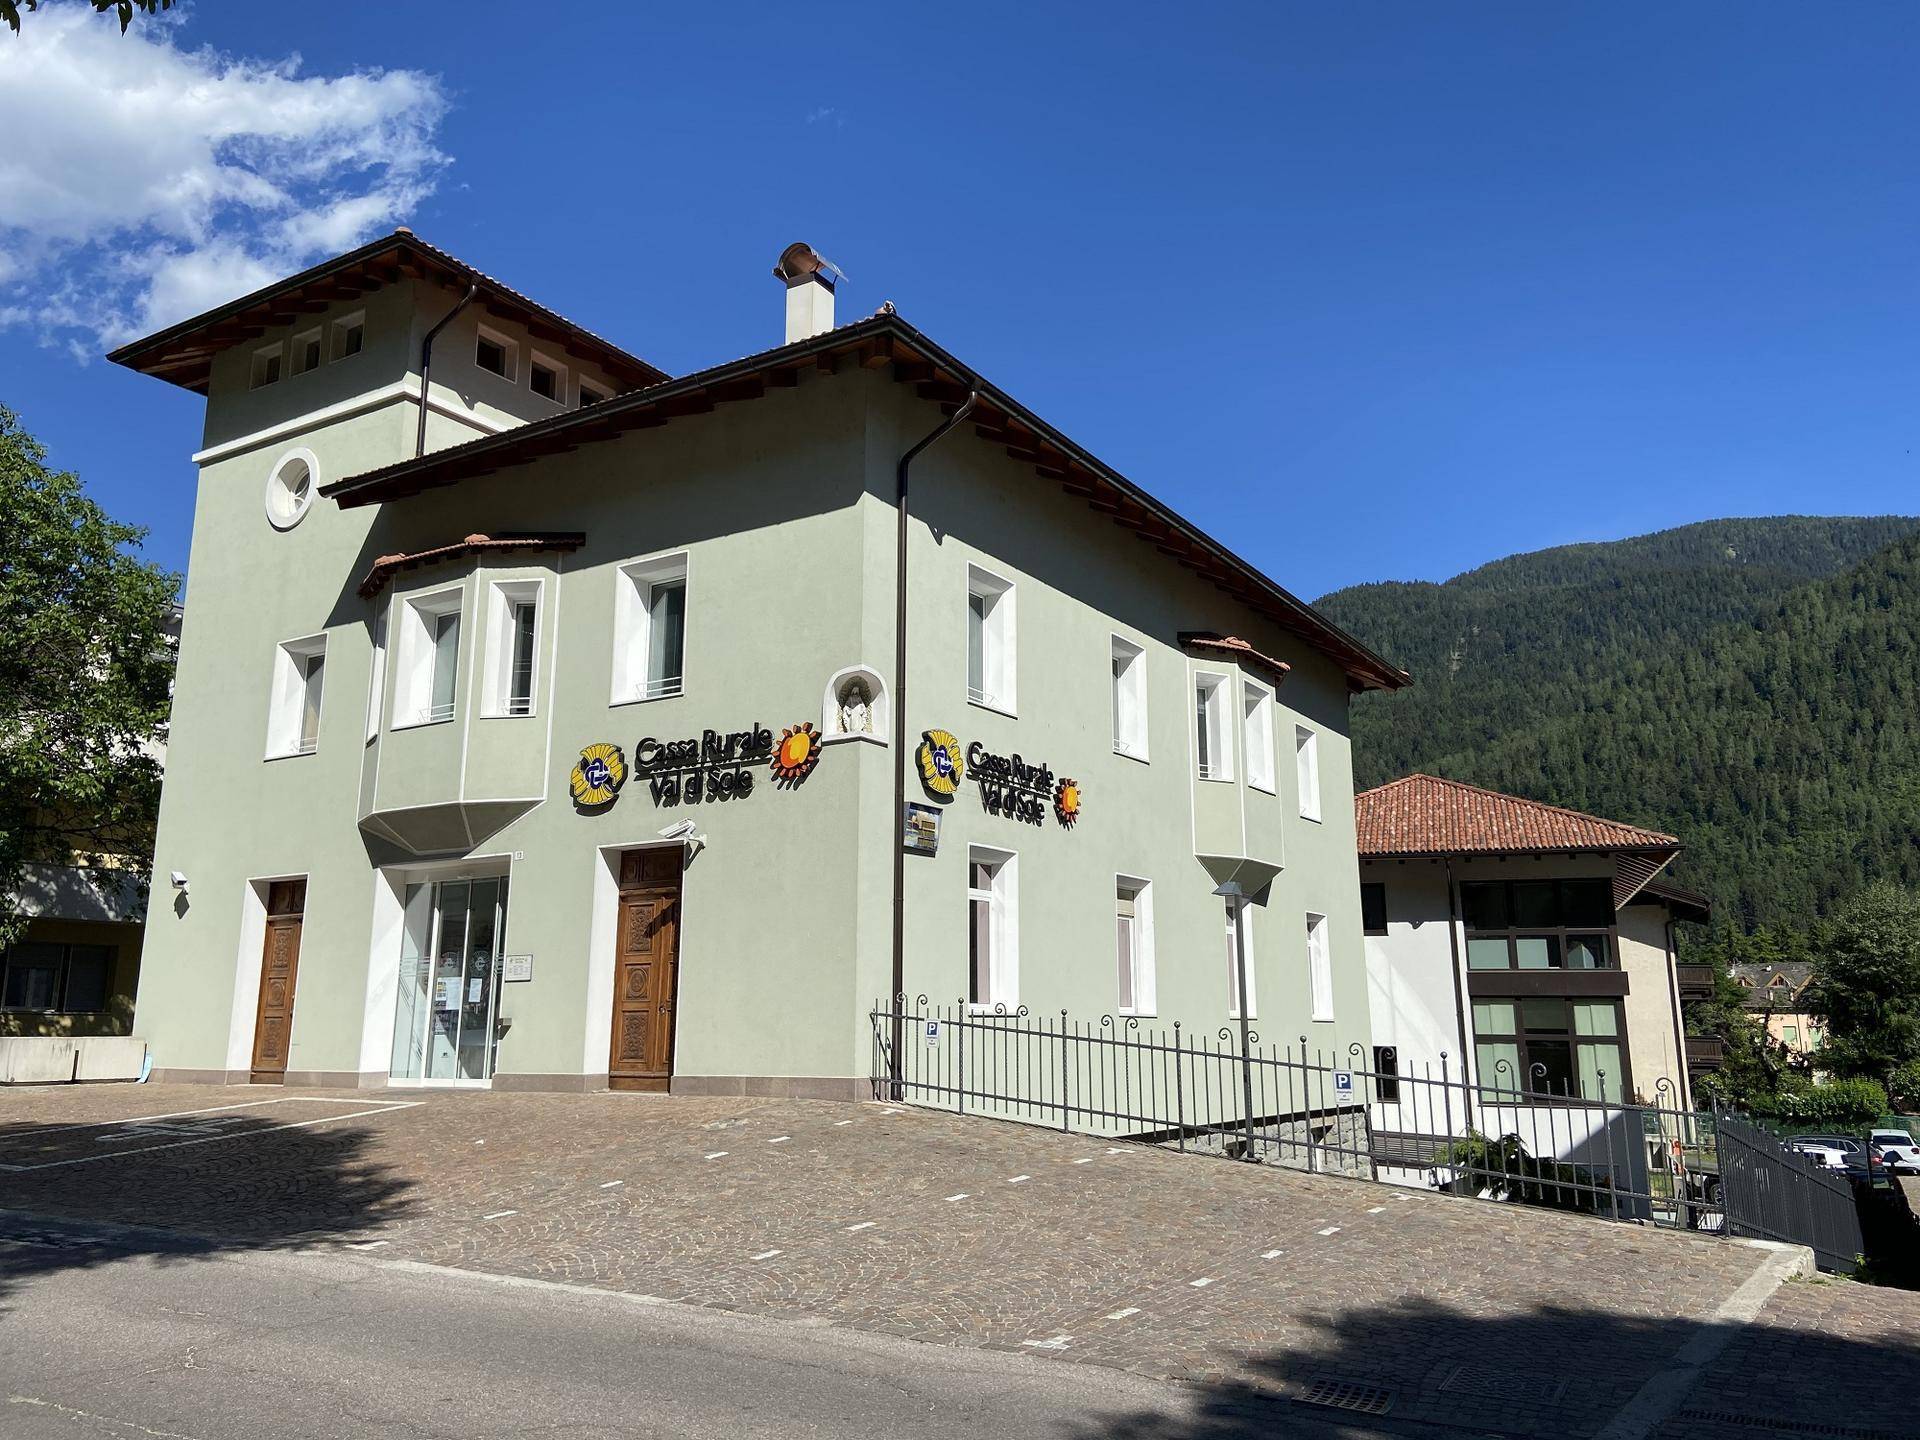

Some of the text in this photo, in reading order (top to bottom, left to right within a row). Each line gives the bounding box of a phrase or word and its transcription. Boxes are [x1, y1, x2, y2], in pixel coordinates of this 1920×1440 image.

[635, 722, 772, 763] Cassa Rurale
[650, 764, 753, 801] Val di Sole
[967, 741, 1054, 788] Cassa Rurale
[979, 779, 1001, 811] Val
[1016, 789, 1045, 821] Sole
[1337, 1074, 1348, 1088] P
